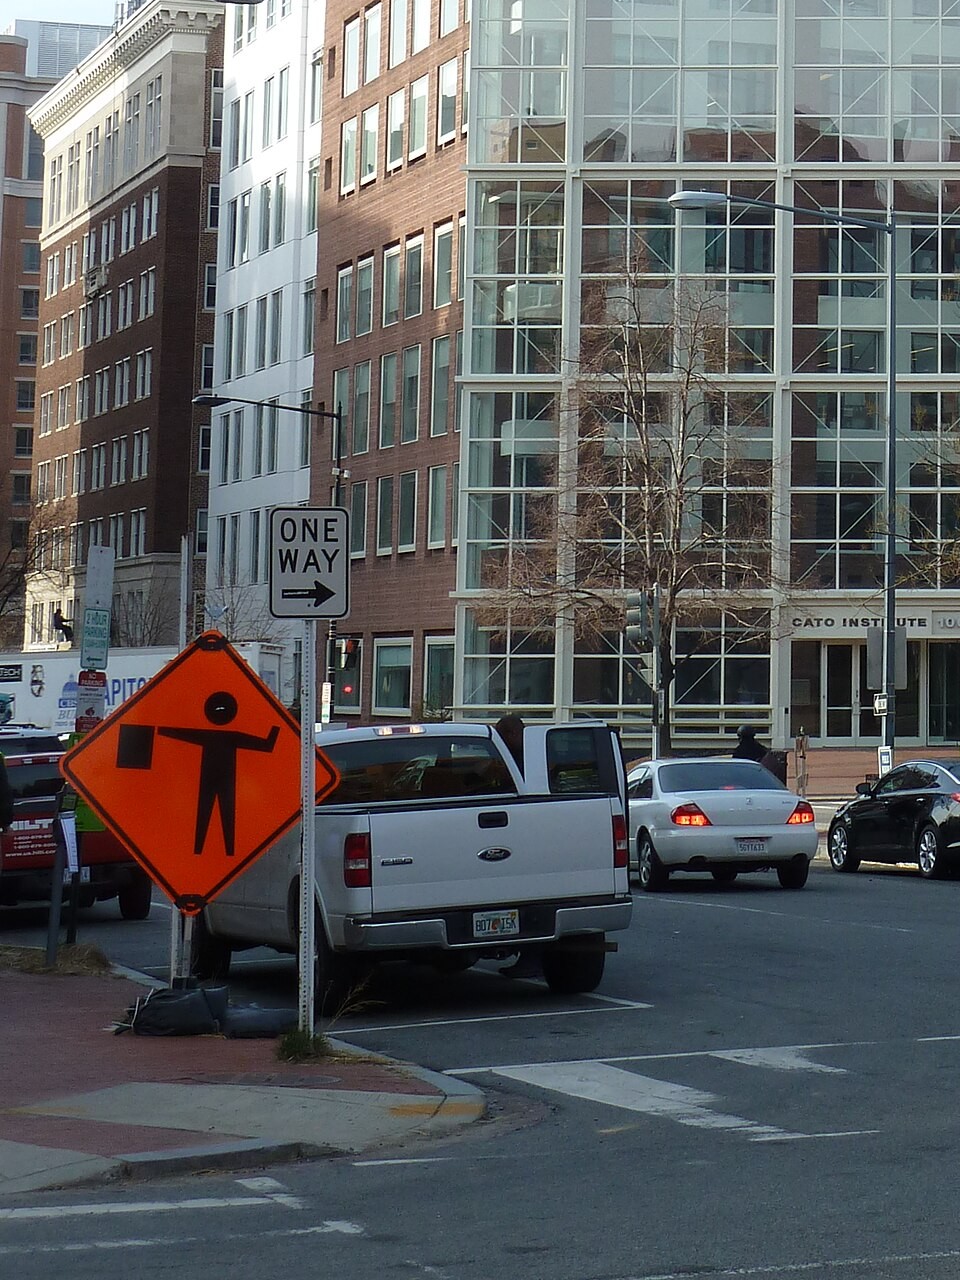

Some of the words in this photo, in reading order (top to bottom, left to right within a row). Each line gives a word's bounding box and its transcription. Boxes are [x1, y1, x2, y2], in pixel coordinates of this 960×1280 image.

[280, 517, 339, 543] ONE
[278, 548, 340, 574] WAY
[792, 618, 835, 628] CATO
[842, 618, 927, 628] INSTIUTE
[485, 848, 505, 859] Ford
